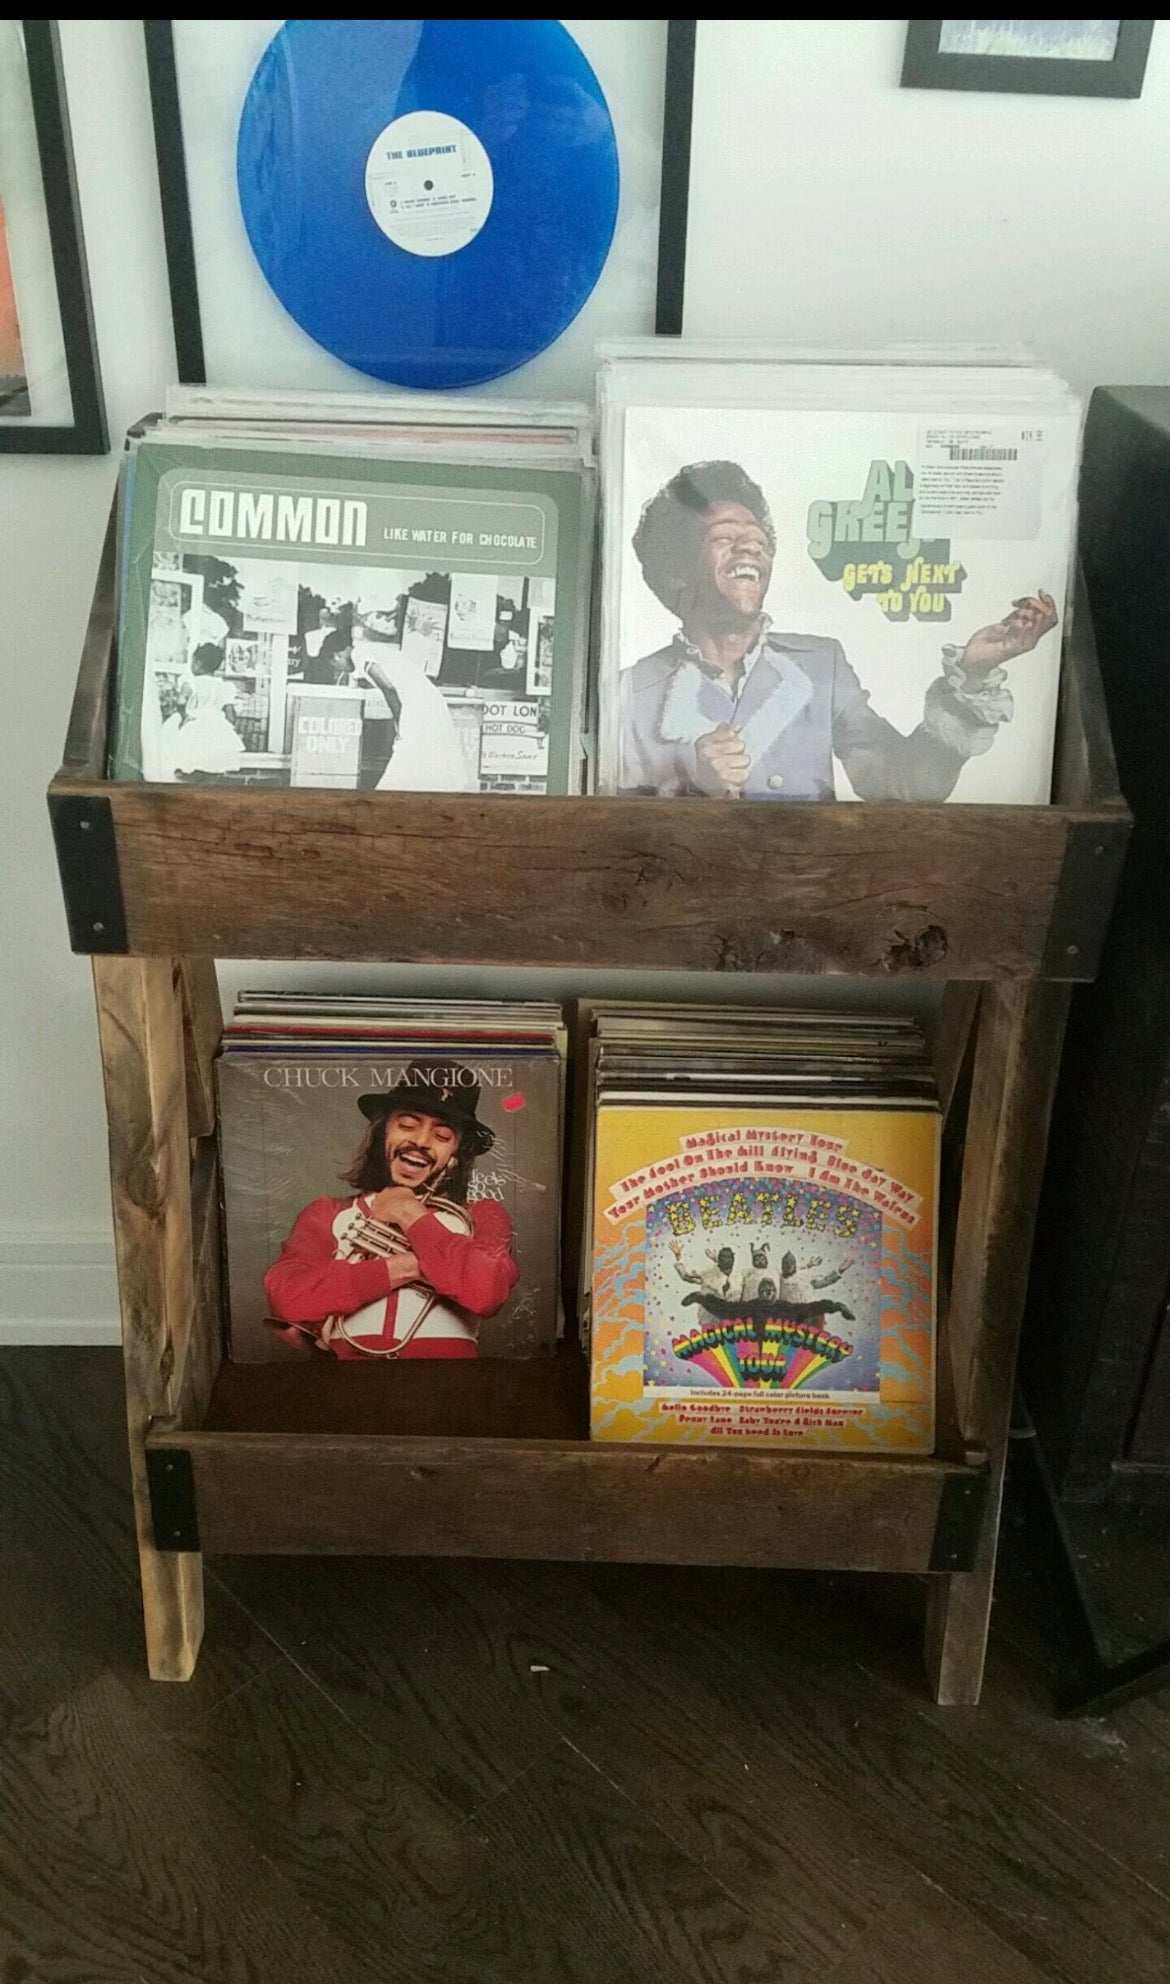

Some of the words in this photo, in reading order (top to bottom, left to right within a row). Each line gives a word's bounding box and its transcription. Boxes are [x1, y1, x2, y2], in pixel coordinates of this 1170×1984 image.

[386, 151, 403, 160] THE
[406, 145, 457, 159] BLUEPRINT
[862, 460, 914, 501] AL
[179, 488, 368, 547] COMMON
[383, 527, 408, 541] LIKE
[412, 529, 447, 544] WATER
[451, 531, 474, 545] FOR
[479, 533, 538, 549] CHOCOLATE
[806, 500, 936, 559] GREE
[843, 560, 893, 592] GETS
[900, 557, 961, 592] NEXT
[876, 589, 903, 613] TO
[909, 585, 946, 613] YOU
[485, 724, 502, 732] HOT
[263, 1067, 359, 1088] CHUCK
[371, 1067, 513, 1089] MANGIONE
[685, 1129, 741, 1149] Magical
[746, 1129, 804, 1145] Mystery
[810, 1132, 843, 1151] Tour
[471, 1168, 507, 1187] feels
[620, 1174, 647, 1193] The
[649, 1158, 681, 1180] Fool
[683, 1154, 704, 1167] On
[707, 1148, 733, 1161] The
[737, 1145, 765, 1157] Hill
[771, 1146, 818, 1164] Flying
[827, 1155, 858, 1174] Blue
[890, 1181, 915, 1203] Way
[466, 1187, 505, 1204] good
[608, 1195, 641, 1219] Your
[643, 1172, 695, 1200] Mother
[699, 1161, 749, 1179] Should
[754, 1160, 795, 1174] Know
[808, 1167, 816, 1178] I
[818, 1170, 841, 1185] Am
[844, 1177, 870, 1196] The
[873, 1190, 916, 1225] Walrus
[667, 1192, 860, 1238] BEATLES
[671, 1317, 757, 1361] MAGICAL
[764, 1317, 854, 1363] MYSTERY
[737, 1352, 787, 1381] TOUR
[690, 1389, 720, 1397] Includes
[722, 1389, 752, 1398] 24-page
[753, 1390, 765, 1398] full
[766, 1391, 784, 1399] color
[785, 1391, 811, 1400] picture
[812, 1392, 830, 1400] book
[661, 1403, 687, 1412] Hello
[689, 1404, 731, 1413] Goodbye
[739, 1405, 794, 1416] Strawberry
[795, 1406, 824, 1415] Fields
[679, 1414, 707, 1424] Penny
[710, 1415, 733, 1424] Lane
[739, 1416, 760, 1427] Baby
[803, 1417, 823, 1427] Rich
[825, 1418, 844, 1427] Man
[710, 1426, 724, 1435] All
[726, 1427, 743, 1436] You
[783, 1428, 804, 1437] Love
